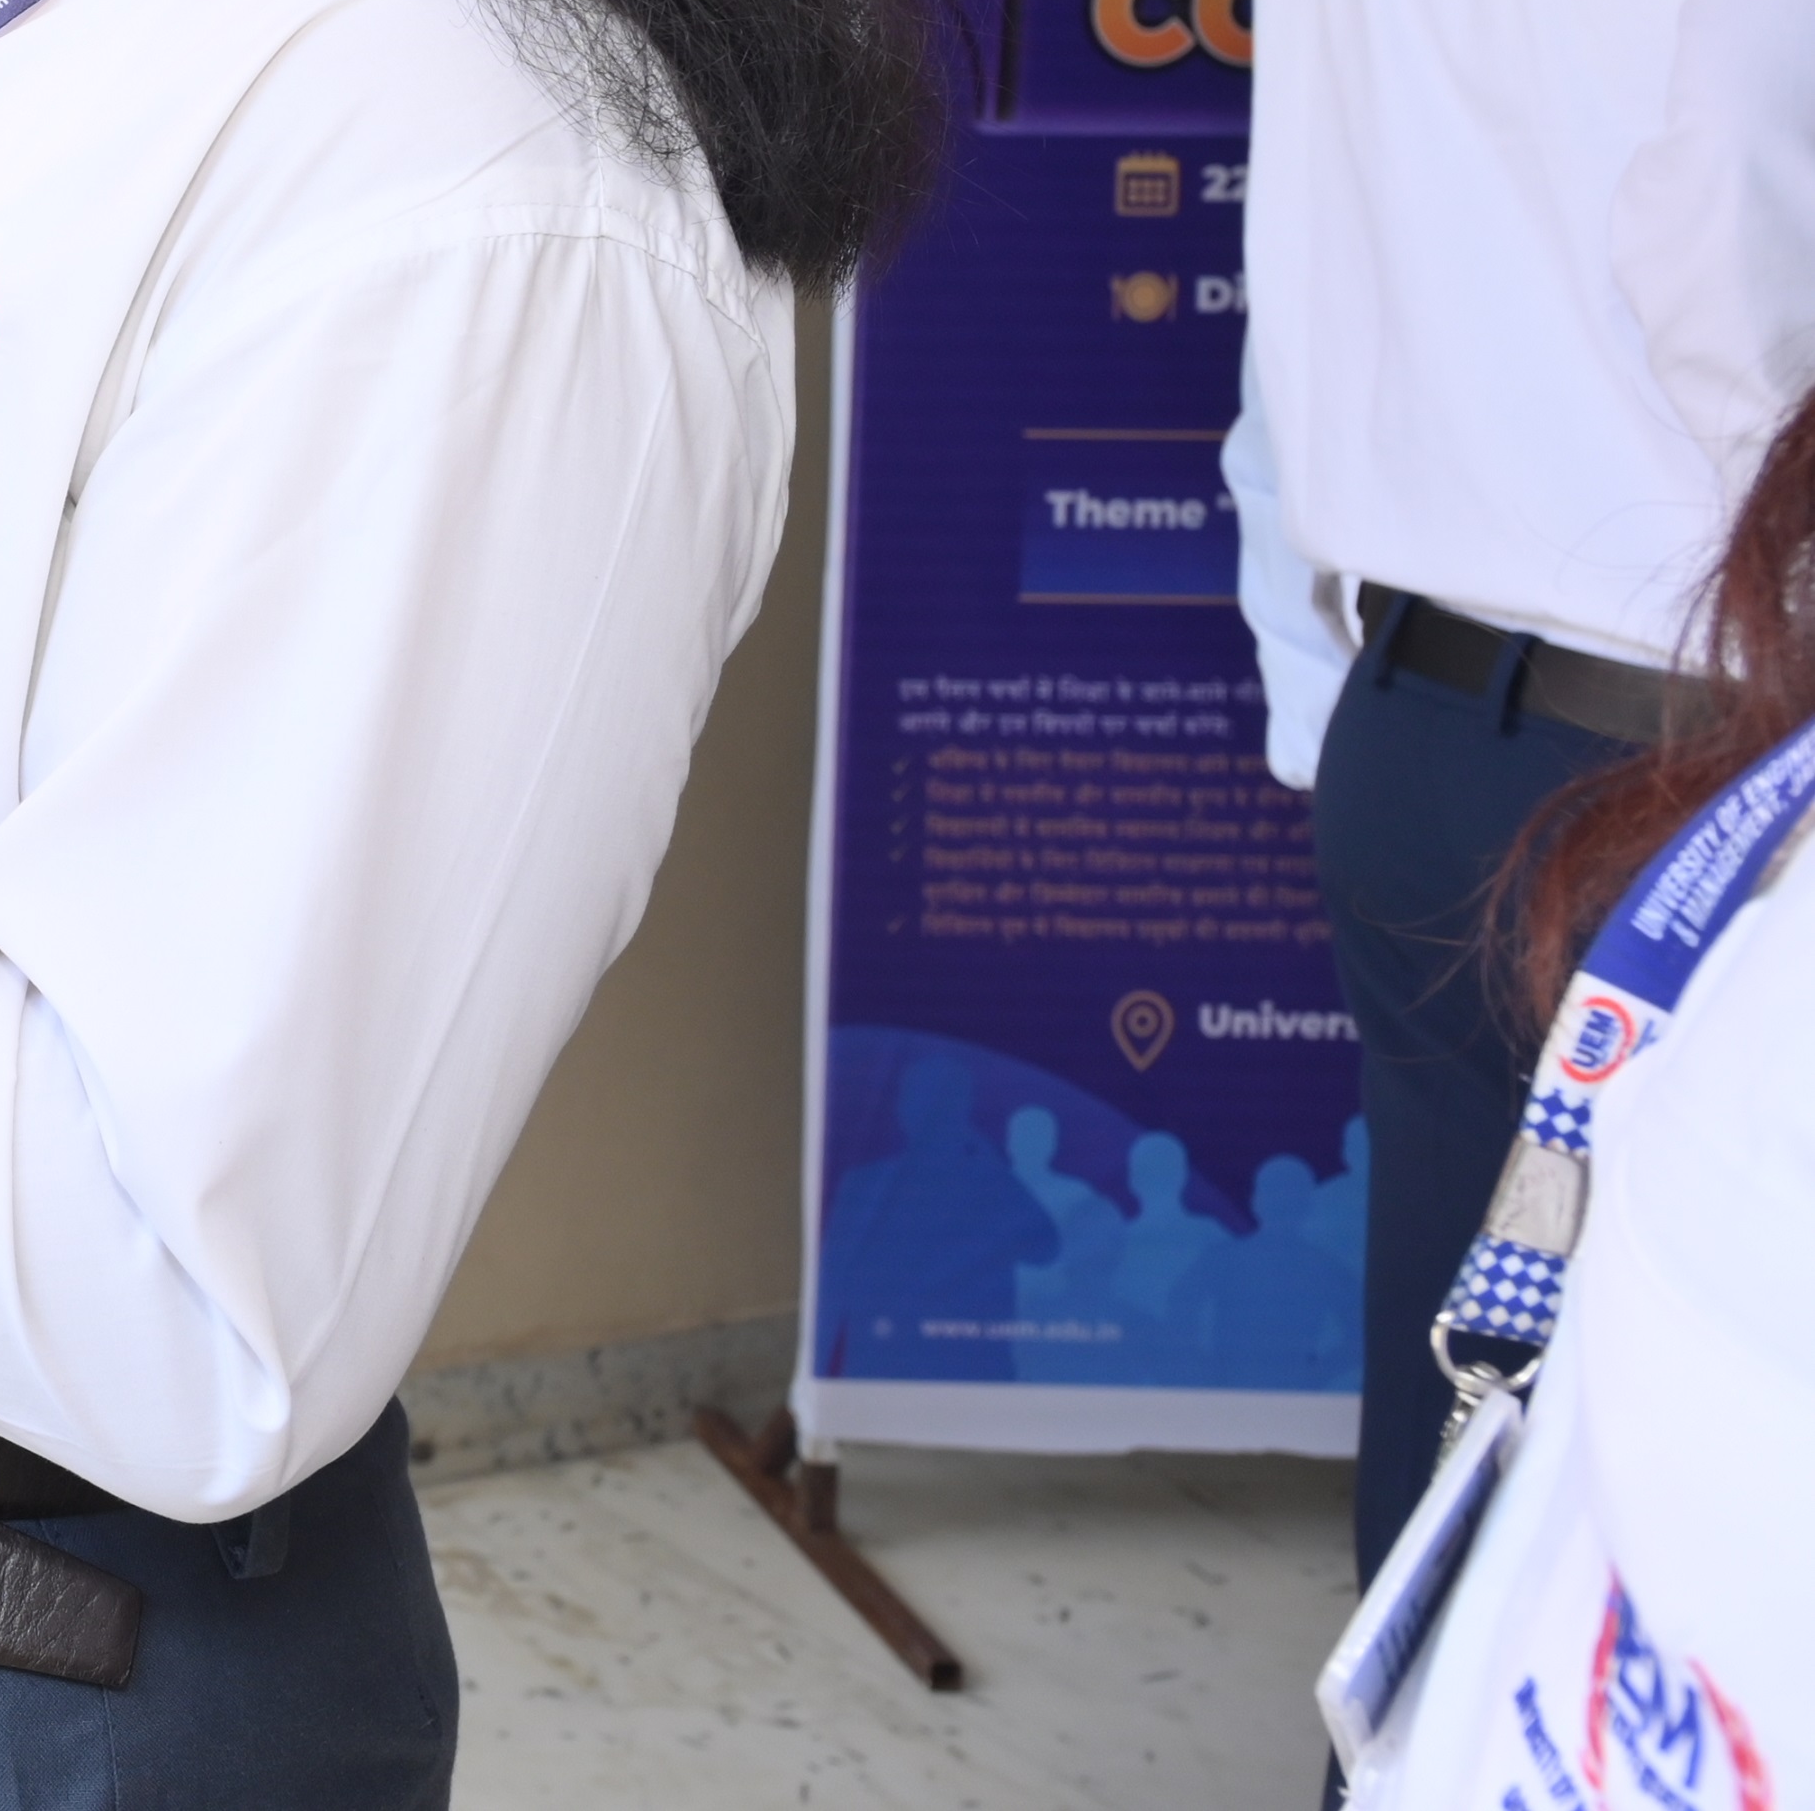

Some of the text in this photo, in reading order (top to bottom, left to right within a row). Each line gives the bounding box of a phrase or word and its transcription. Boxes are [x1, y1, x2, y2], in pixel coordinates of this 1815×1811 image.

[1044, 488, 1208, 530] Theme
[1630, 818, 1722, 942] UNIVERSITY
[1571, 1008, 1617, 1070] UEM
